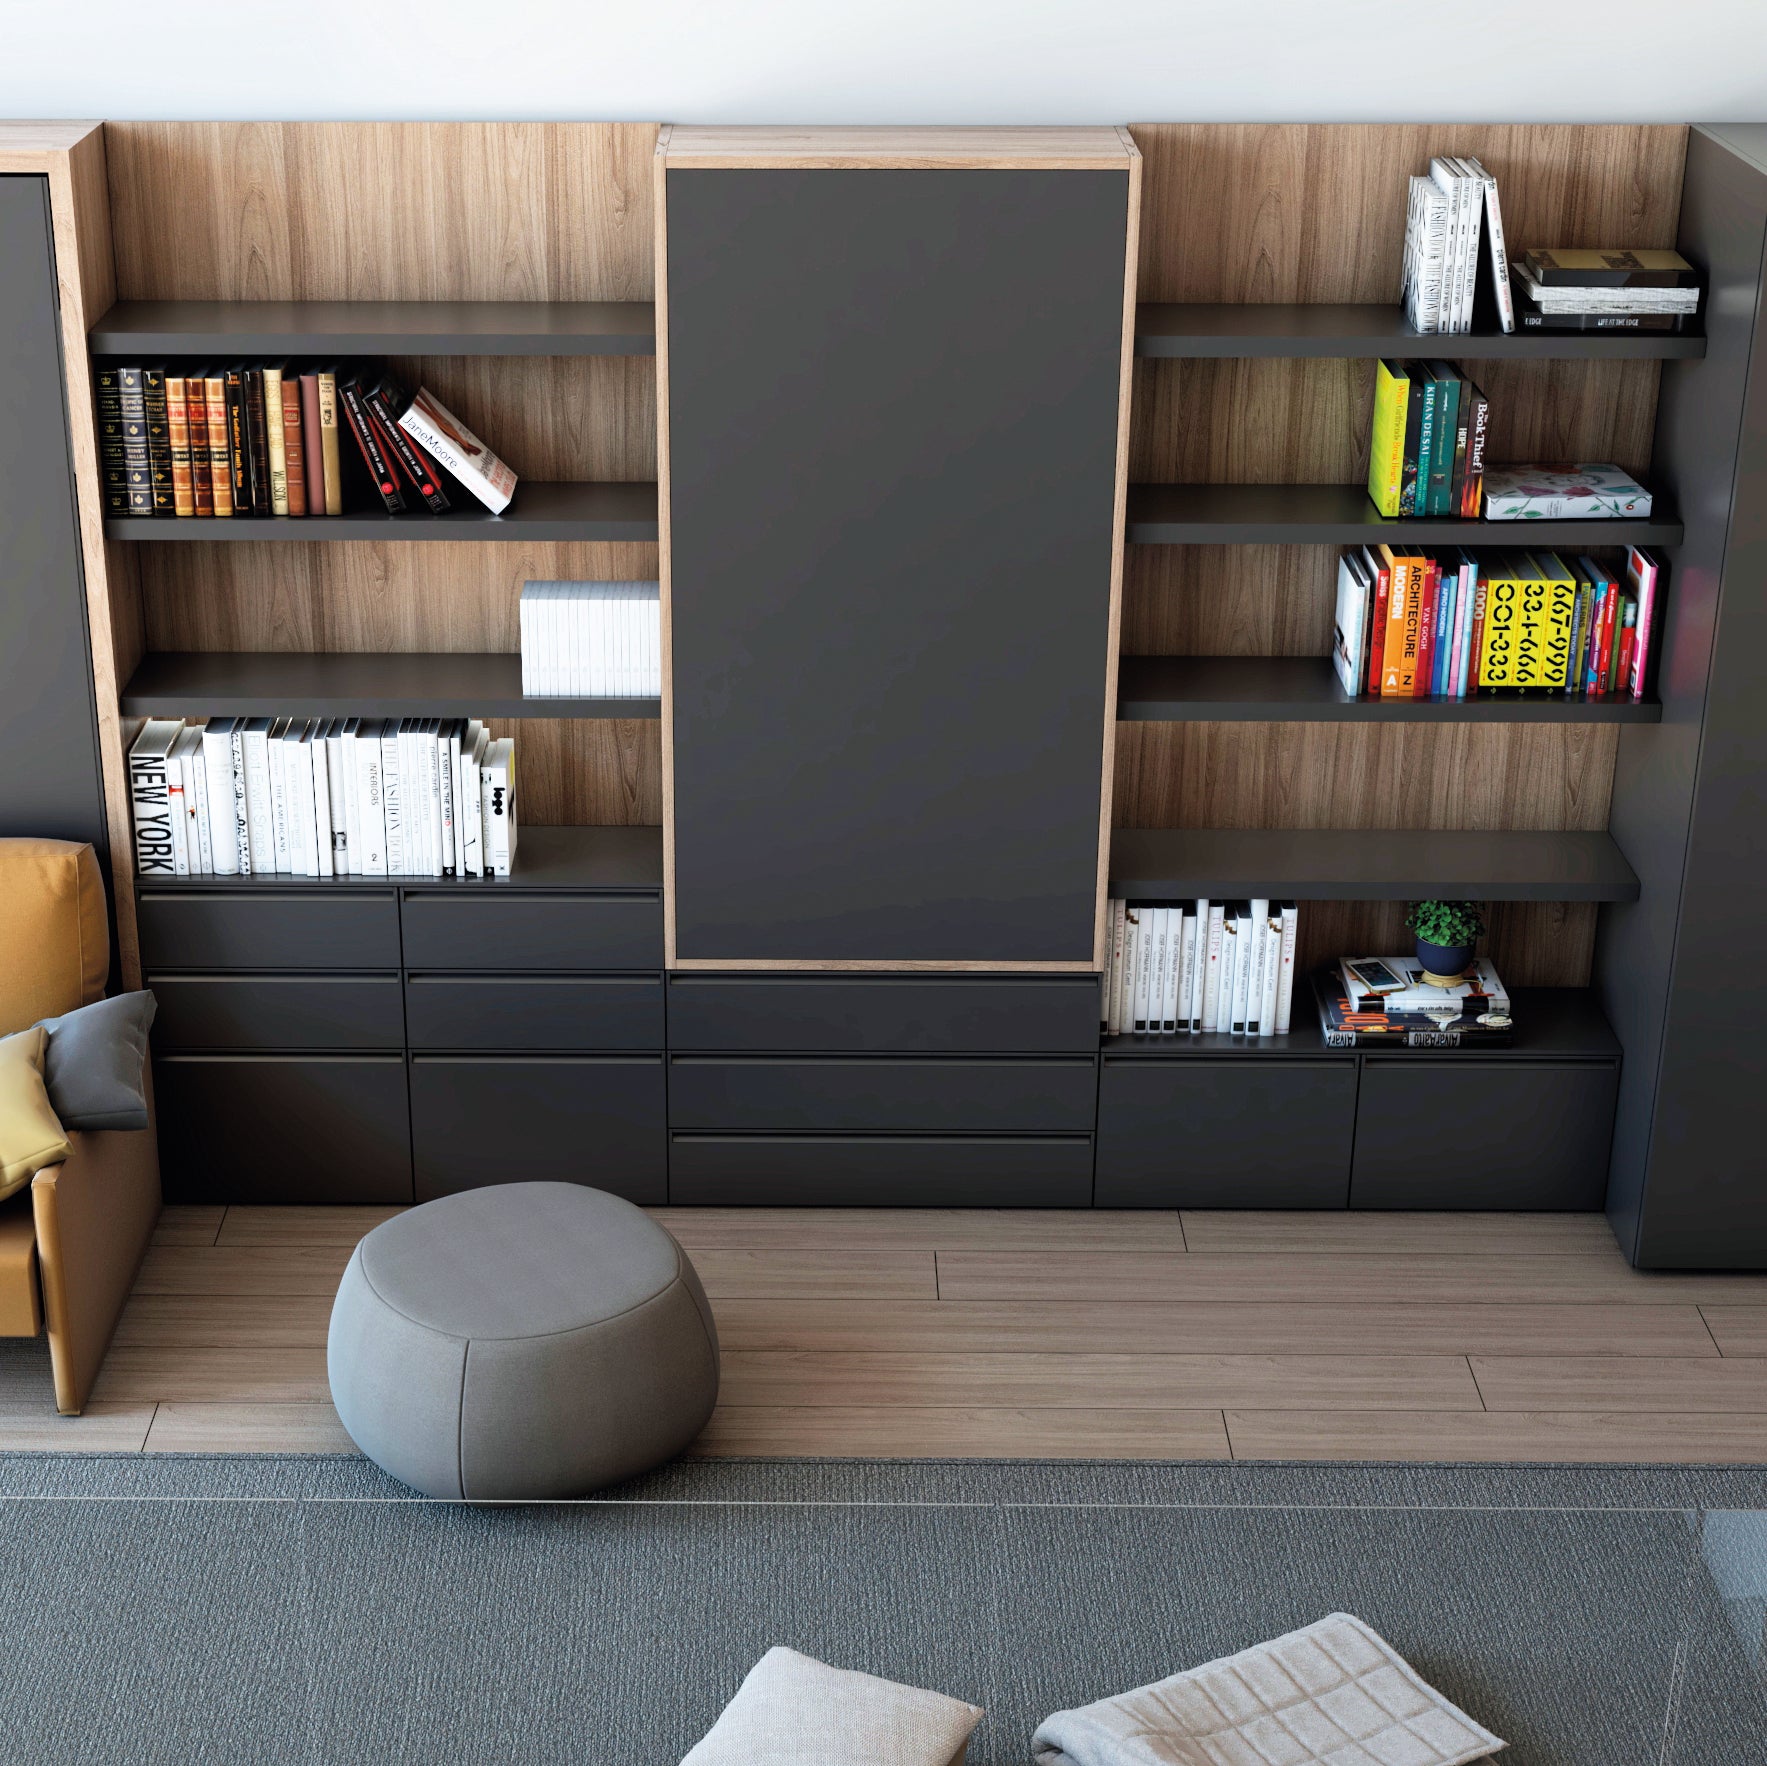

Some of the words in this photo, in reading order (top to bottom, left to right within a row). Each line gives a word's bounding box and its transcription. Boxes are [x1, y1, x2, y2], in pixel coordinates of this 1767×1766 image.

[1425, 386, 1436, 421] KIRAN
[1476, 403, 1488, 431] Book
[1422, 422, 1432, 454] DESAI
[1458, 428, 1467, 449] HOPE
[1474, 432, 1485, 472] Thief
[1379, 576, 1388, 597] Swiss
[1392, 566, 1407, 619] MODERN
[1474, 586, 1486, 620] 1000
[1404, 566, 1422, 658] ARCHITECTURE
[1386, 674, 1397, 686] A
[131, 756, 168, 805] NEW
[370, 763, 379, 806] INTERIORS
[492, 787, 505, 815] logo
[136, 814, 174, 872] YORK
[372, 853, 377, 862] 2
[1212, 916, 1221, 952] TULIPS
[1284, 919, 1294, 955] TULIPS
